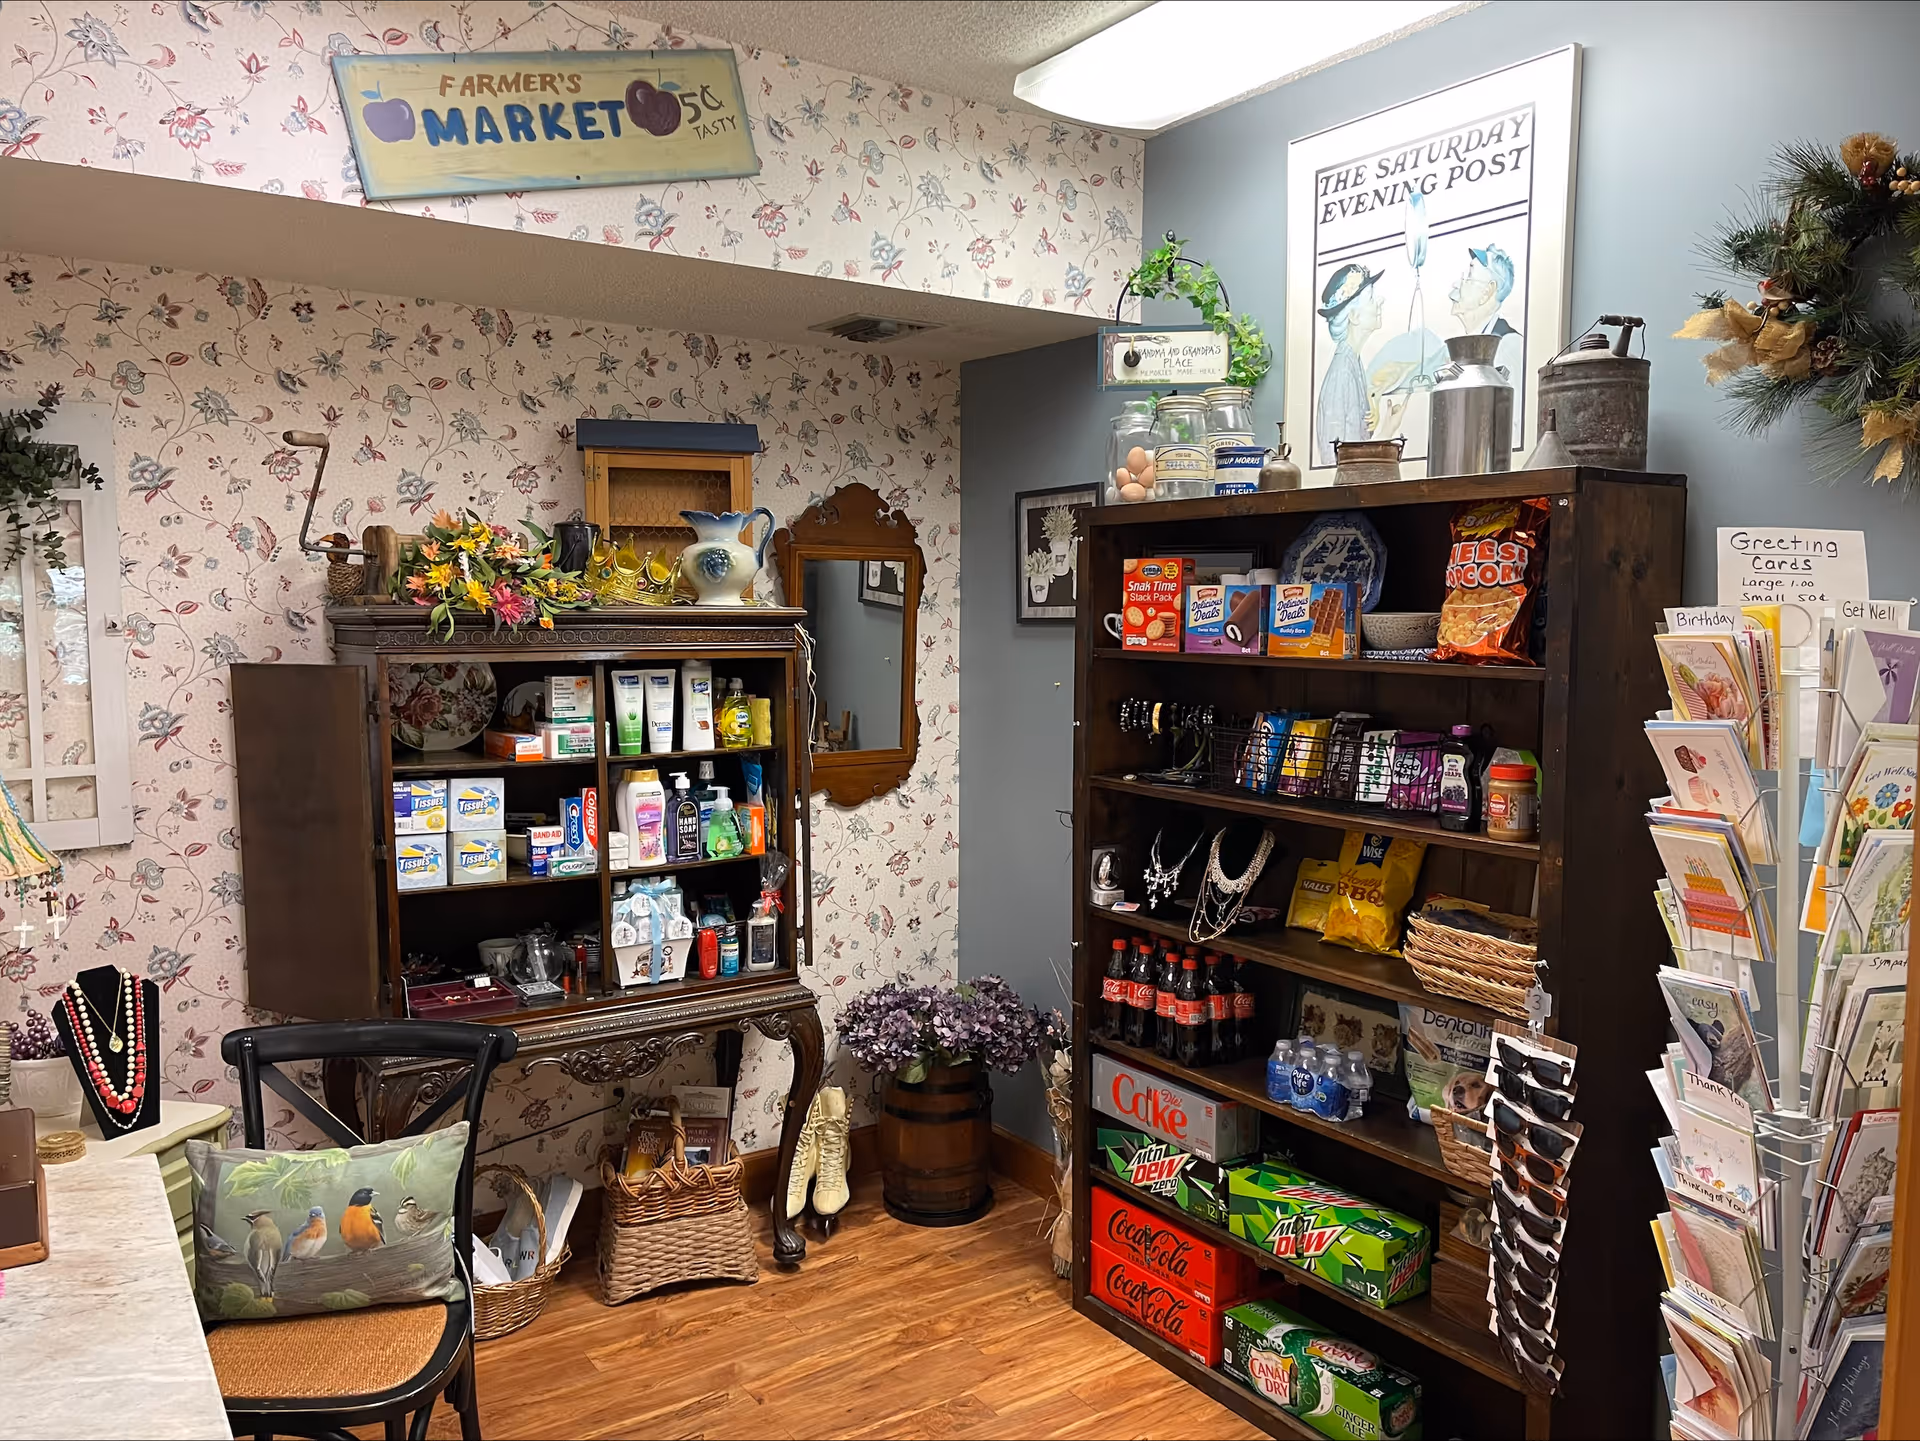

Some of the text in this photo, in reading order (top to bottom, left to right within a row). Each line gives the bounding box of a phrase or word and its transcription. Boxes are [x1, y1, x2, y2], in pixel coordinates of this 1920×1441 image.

[439, 72, 582, 98] FARMER'S
[680, 84, 724, 125] 5¢
[421, 100, 626, 147] MARKET
[692, 114, 737, 141] TASTY
[1319, 112, 1530, 198] THE SATURDAY
[1319, 144, 1530, 225] EVENING POST
[1168, 347, 1180, 356] AND
[1182, 344, 1221, 356] GRANDPA'S
[1163, 358, 1193, 368] PLACE
[1234, 457, 1260, 465] MORRIS
[1447, 539, 1528, 569] HEESE
[1730, 532, 1838, 558] Greeting
[1752, 555, 1813, 571] Cards
[1446, 562, 1526, 588] OPCORN
[1742, 577, 1785, 590] Large
[1127, 581, 1177, 592] Snak Time
[1130, 592, 1173, 601] Stack Pack
[1191, 597, 1223, 612] Delicious
[1277, 597, 1308, 611] Delicious
[1740, 592, 1785, 602] Small
[1194, 606, 1221, 622] Deals
[1280, 606, 1306, 622] Deals
[1843, 601, 1895, 621] Get Well
[1676, 612, 1735, 630] Birthday
[1372, 733, 1388, 789] Junior
[1865, 771, 1881, 784] Get
[1883, 766, 1905, 778] Well
[414, 797, 444, 809] TISSUES
[459, 800, 489, 812] TISSUES
[586, 790, 597, 836] Colgate
[679, 817, 696, 825] HAND
[569, 803, 580, 845] Crest
[679, 825, 696, 833] SOAP
[461, 853, 491, 866] TISSUES
[1363, 846, 1384, 859] WISE
[399, 857, 430, 870] TISSUES
[1302, 879, 1332, 893] HALLS
[1339, 868, 1383, 889] Honey
[1337, 880, 1384, 907] BBQ
[1293, 1069, 1311, 1081] Pure
[1293, 1077, 1307, 1088] Life
[1161, 1089, 1183, 1107] Diet
[1686, 1072, 1745, 1109] Thank You
[1112, 1073, 1188, 1140] Coke
[1132, 1146, 1164, 1166] Mtn
[1152, 1178, 1178, 1191] zero
[1675, 1171, 1717, 1202] Thinking
[1726, 1196, 1746, 1215] You
[1207, 1204, 1216, 1218] 12
[1108, 1209, 1193, 1278] CocaCola
[1376, 1230, 1392, 1240] 12
[1127, 1253, 1145, 1266] ZERO
[1204, 1250, 1212, 1258] 12
[1367, 1282, 1379, 1299] 12
[1685, 1279, 1732, 1315] Blank
[1106, 1264, 1191, 1337] CocaCola
[1224, 1316, 1234, 1328] 12
[1246, 1304, 1283, 1324] GINGER
[1310, 1339, 1376, 1370] CANADA
[1249, 1357, 1290, 1383] CANAD
[1842, 1355, 1869, 1395] Holidays
[1265, 1378, 1288, 1398] DRY
[1334, 1405, 1376, 1434] GINGER
[1343, 1421, 1365, 1440] ALE
